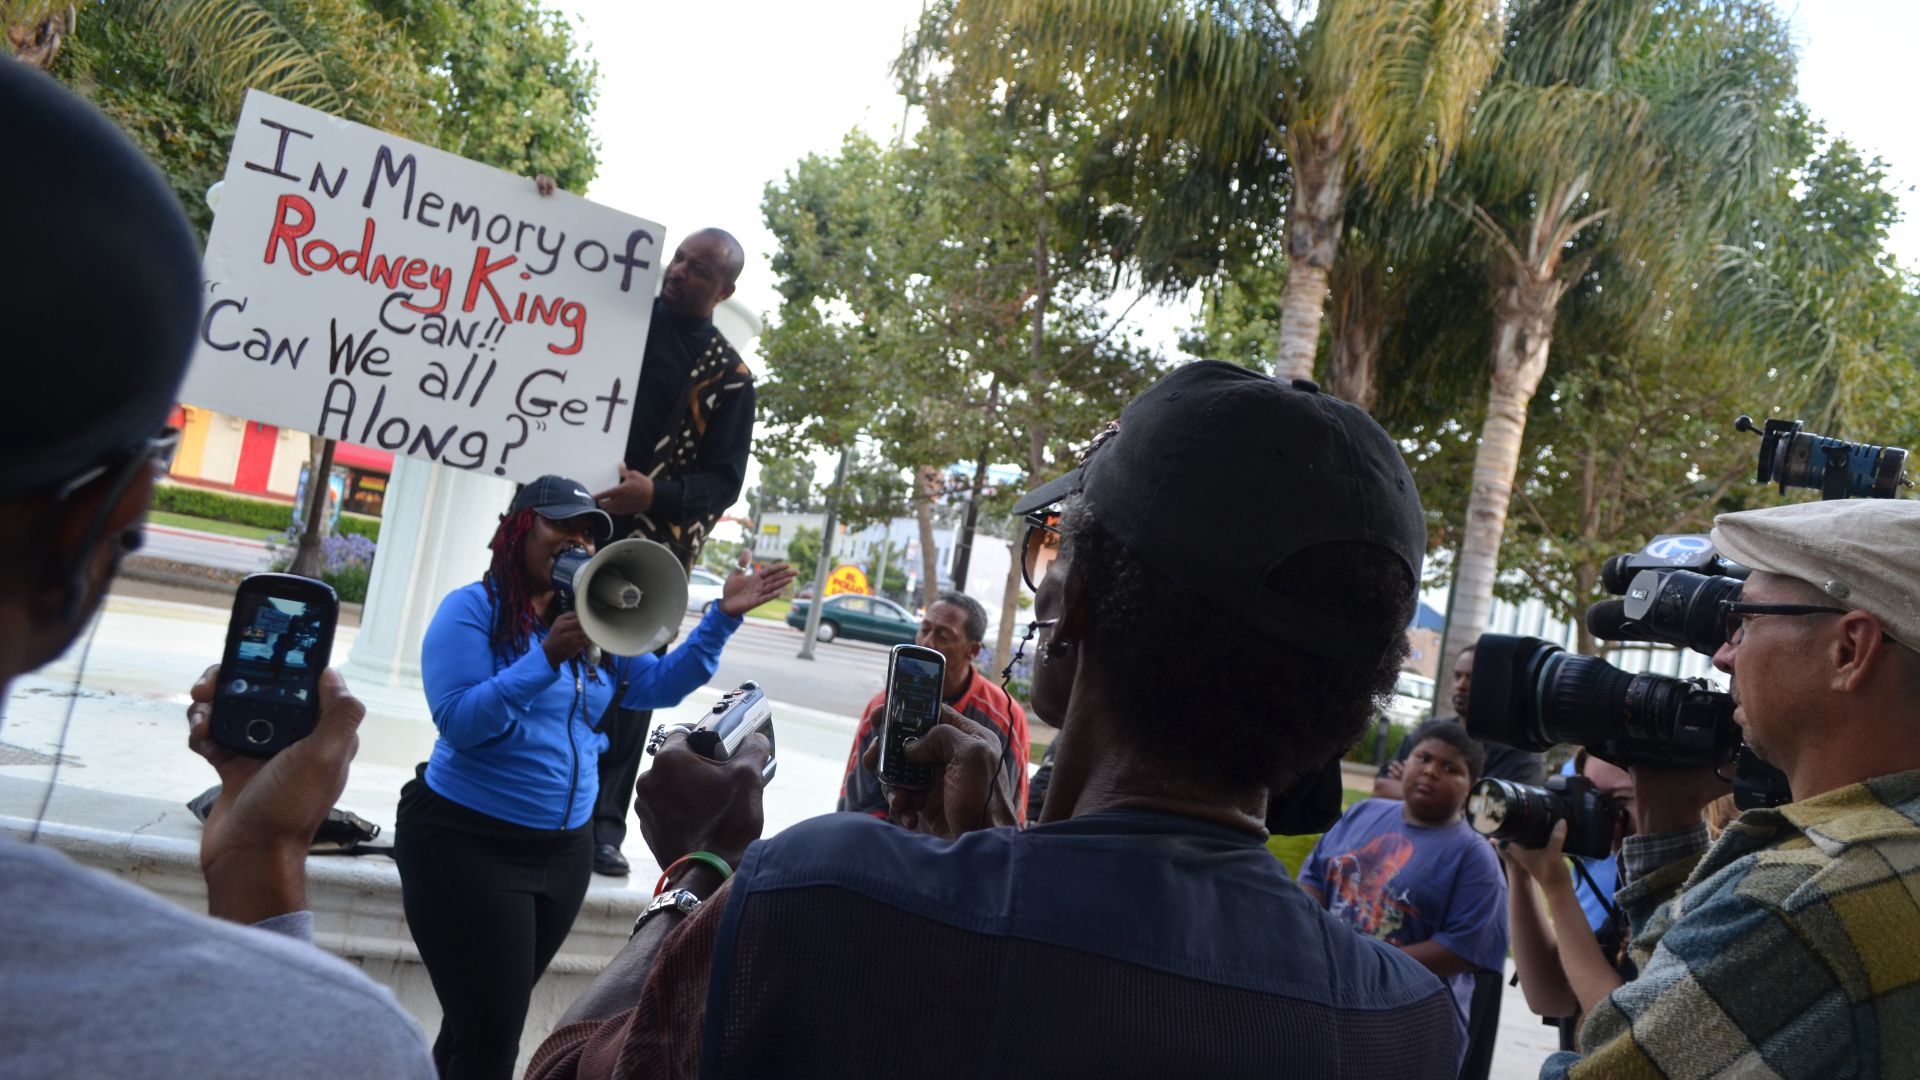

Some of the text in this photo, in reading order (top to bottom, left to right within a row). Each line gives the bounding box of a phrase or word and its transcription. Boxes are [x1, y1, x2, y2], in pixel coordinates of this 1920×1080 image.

[362, 144, 566, 276] Memory
[574, 228, 654, 293] of
[329, 317, 393, 377] We
[418, 352, 497, 408] all
[514, 368, 629, 433] Get
